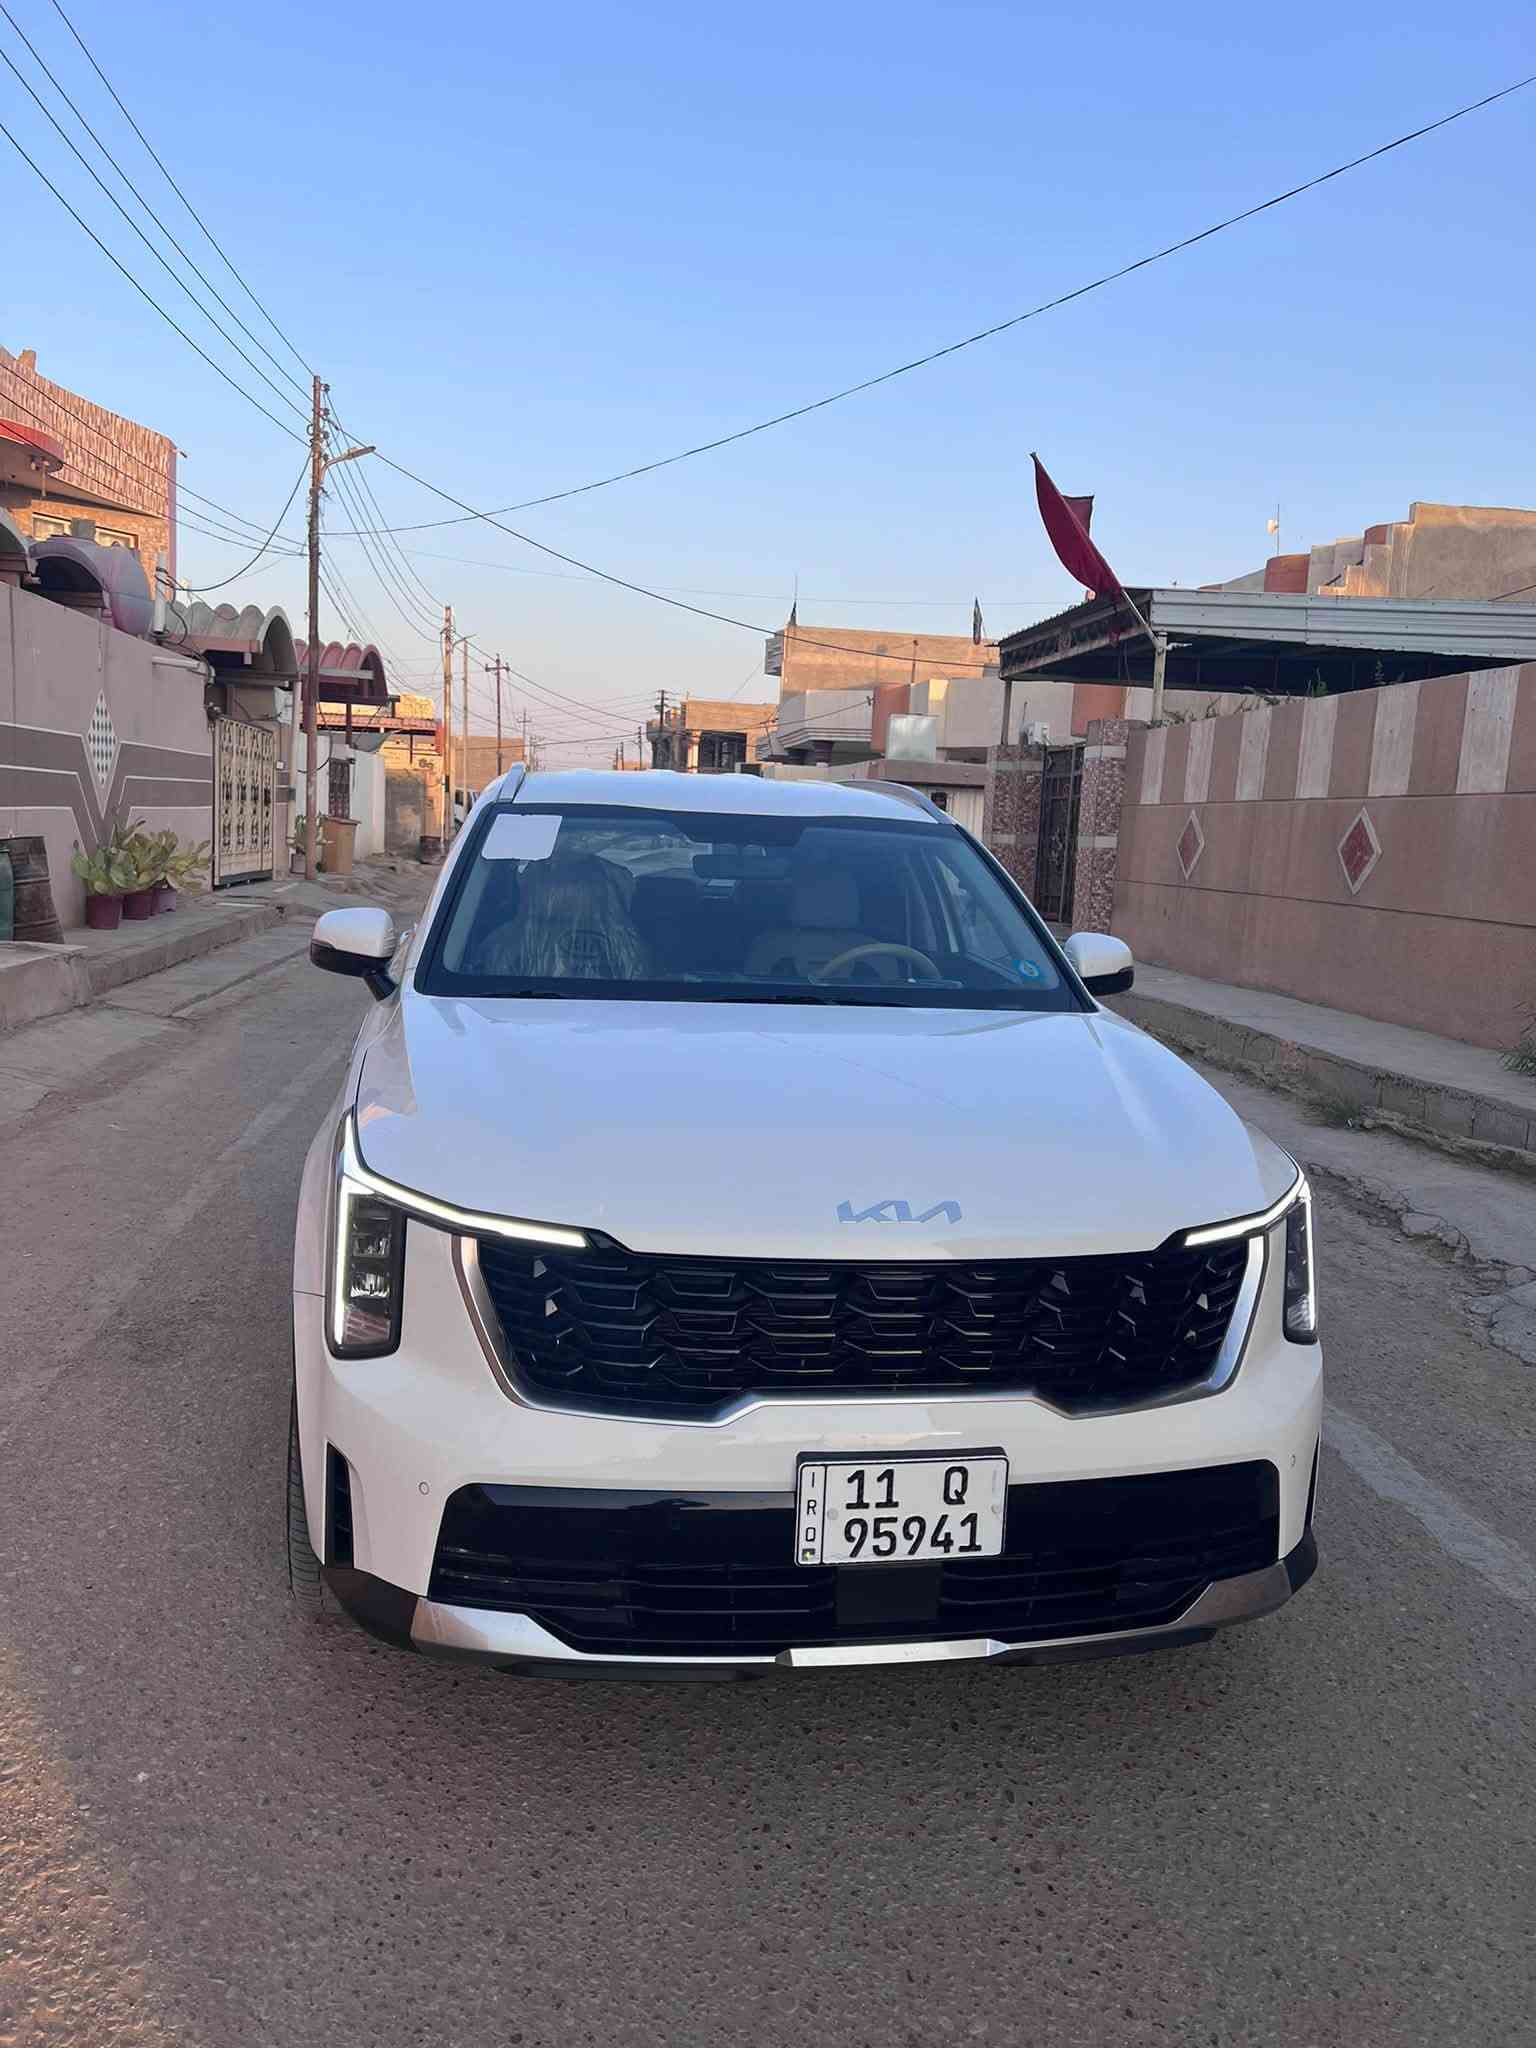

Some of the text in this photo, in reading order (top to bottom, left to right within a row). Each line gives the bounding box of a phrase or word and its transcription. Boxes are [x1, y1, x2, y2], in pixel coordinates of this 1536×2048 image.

[846, 1466, 969, 1510] 11 Q
[844, 1512, 982, 1558] 95941
